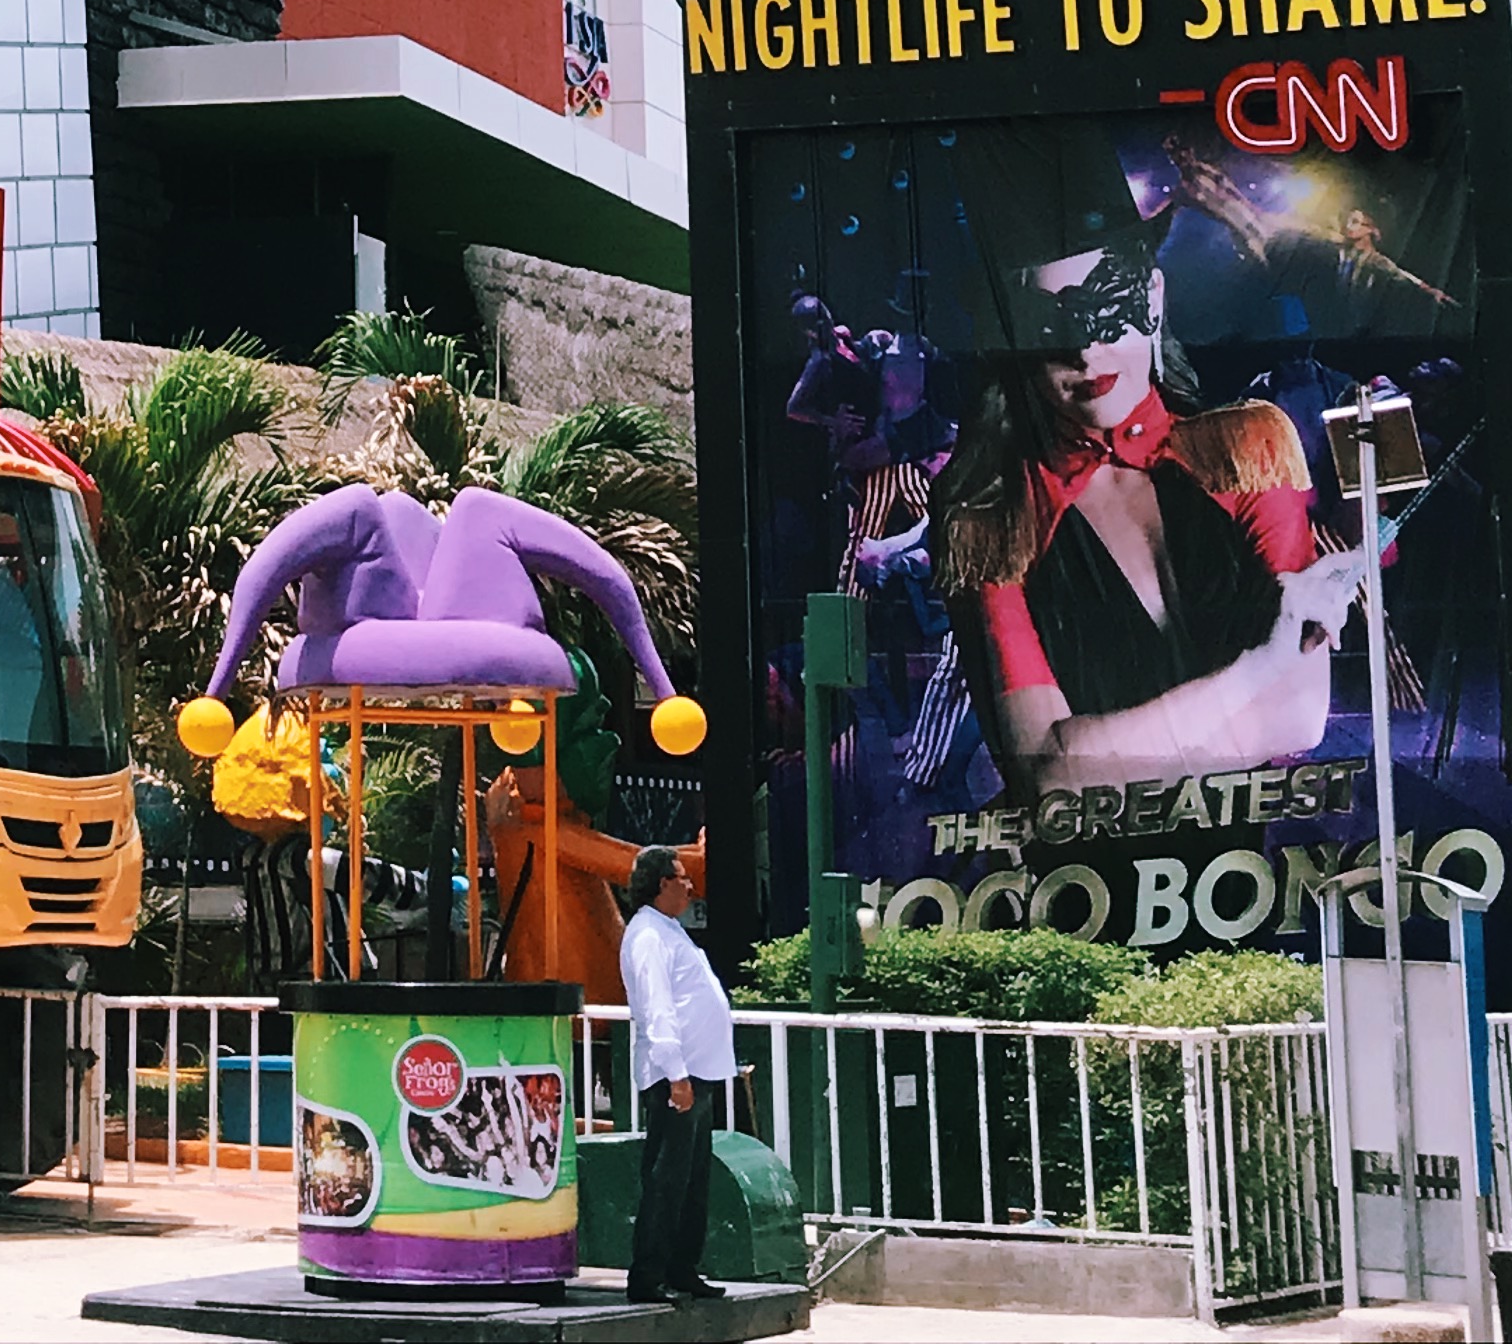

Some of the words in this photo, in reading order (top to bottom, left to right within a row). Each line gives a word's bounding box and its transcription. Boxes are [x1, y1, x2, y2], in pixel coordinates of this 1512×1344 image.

[928, 807, 1033, 856] THE
[1037, 759, 1368, 845] GREATEST
[858, 864, 1110, 945] OCO
